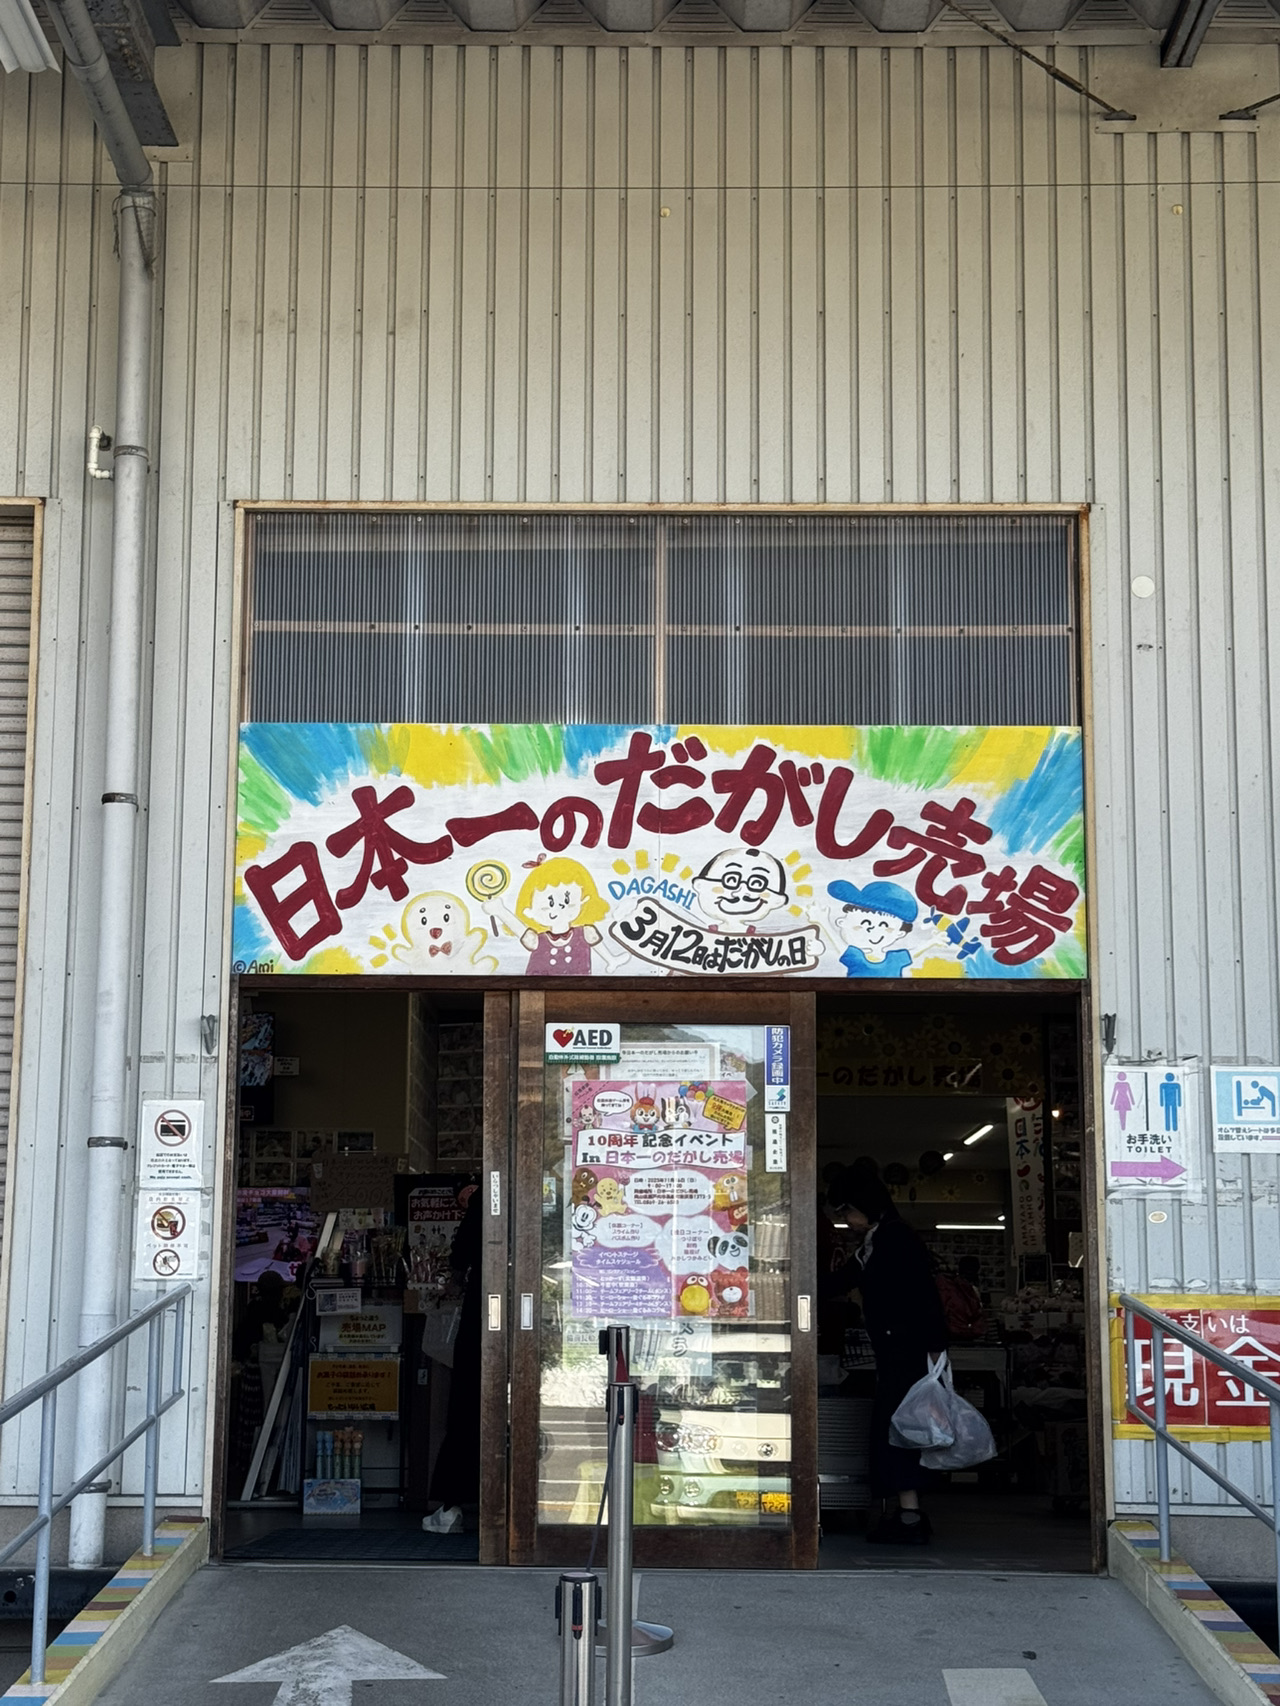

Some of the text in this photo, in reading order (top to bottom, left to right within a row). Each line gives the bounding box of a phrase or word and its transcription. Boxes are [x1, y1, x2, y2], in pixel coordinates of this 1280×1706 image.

[243, 731, 1080, 966] 日本一のだがし売場
[607, 875, 698, 911] DAGASHI
[620, 906, 807, 973] 3月12日はだがしの日
[572, 1029, 613, 1046] AED
[771, 1027, 784, 1086] 防犯カメラ録画中
[587, 1133, 733, 1148] 10周年 記念イベント
[1126, 1134, 1173, 1145] お手洗い
[581, 1150, 743, 1165] In 日本一のだがし売場
[1126, 1146, 1173, 1154] TOILET
[341, 1322, 387, 1333] 売場MAP
